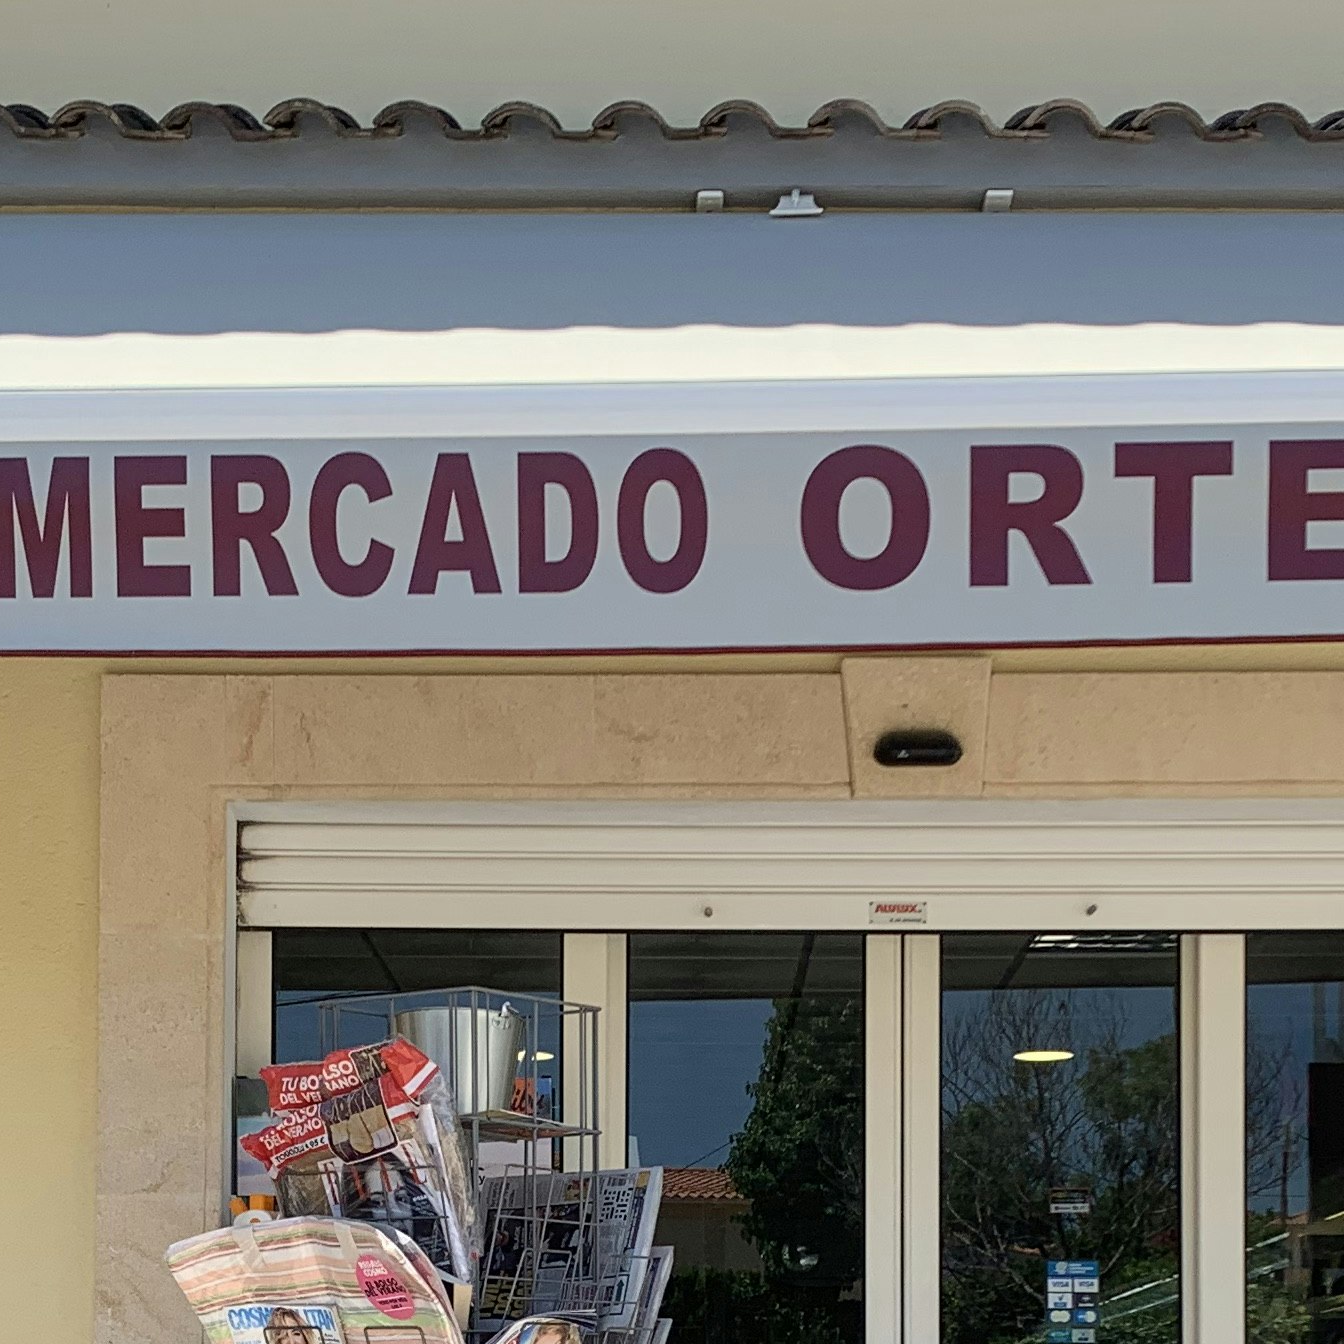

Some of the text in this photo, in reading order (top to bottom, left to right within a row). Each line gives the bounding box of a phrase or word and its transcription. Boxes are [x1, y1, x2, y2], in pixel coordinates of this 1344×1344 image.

[281, 1076, 298, 1091] TU
[280, 1092, 303, 1106] DEL
[263, 1132, 285, 1151] DEL
